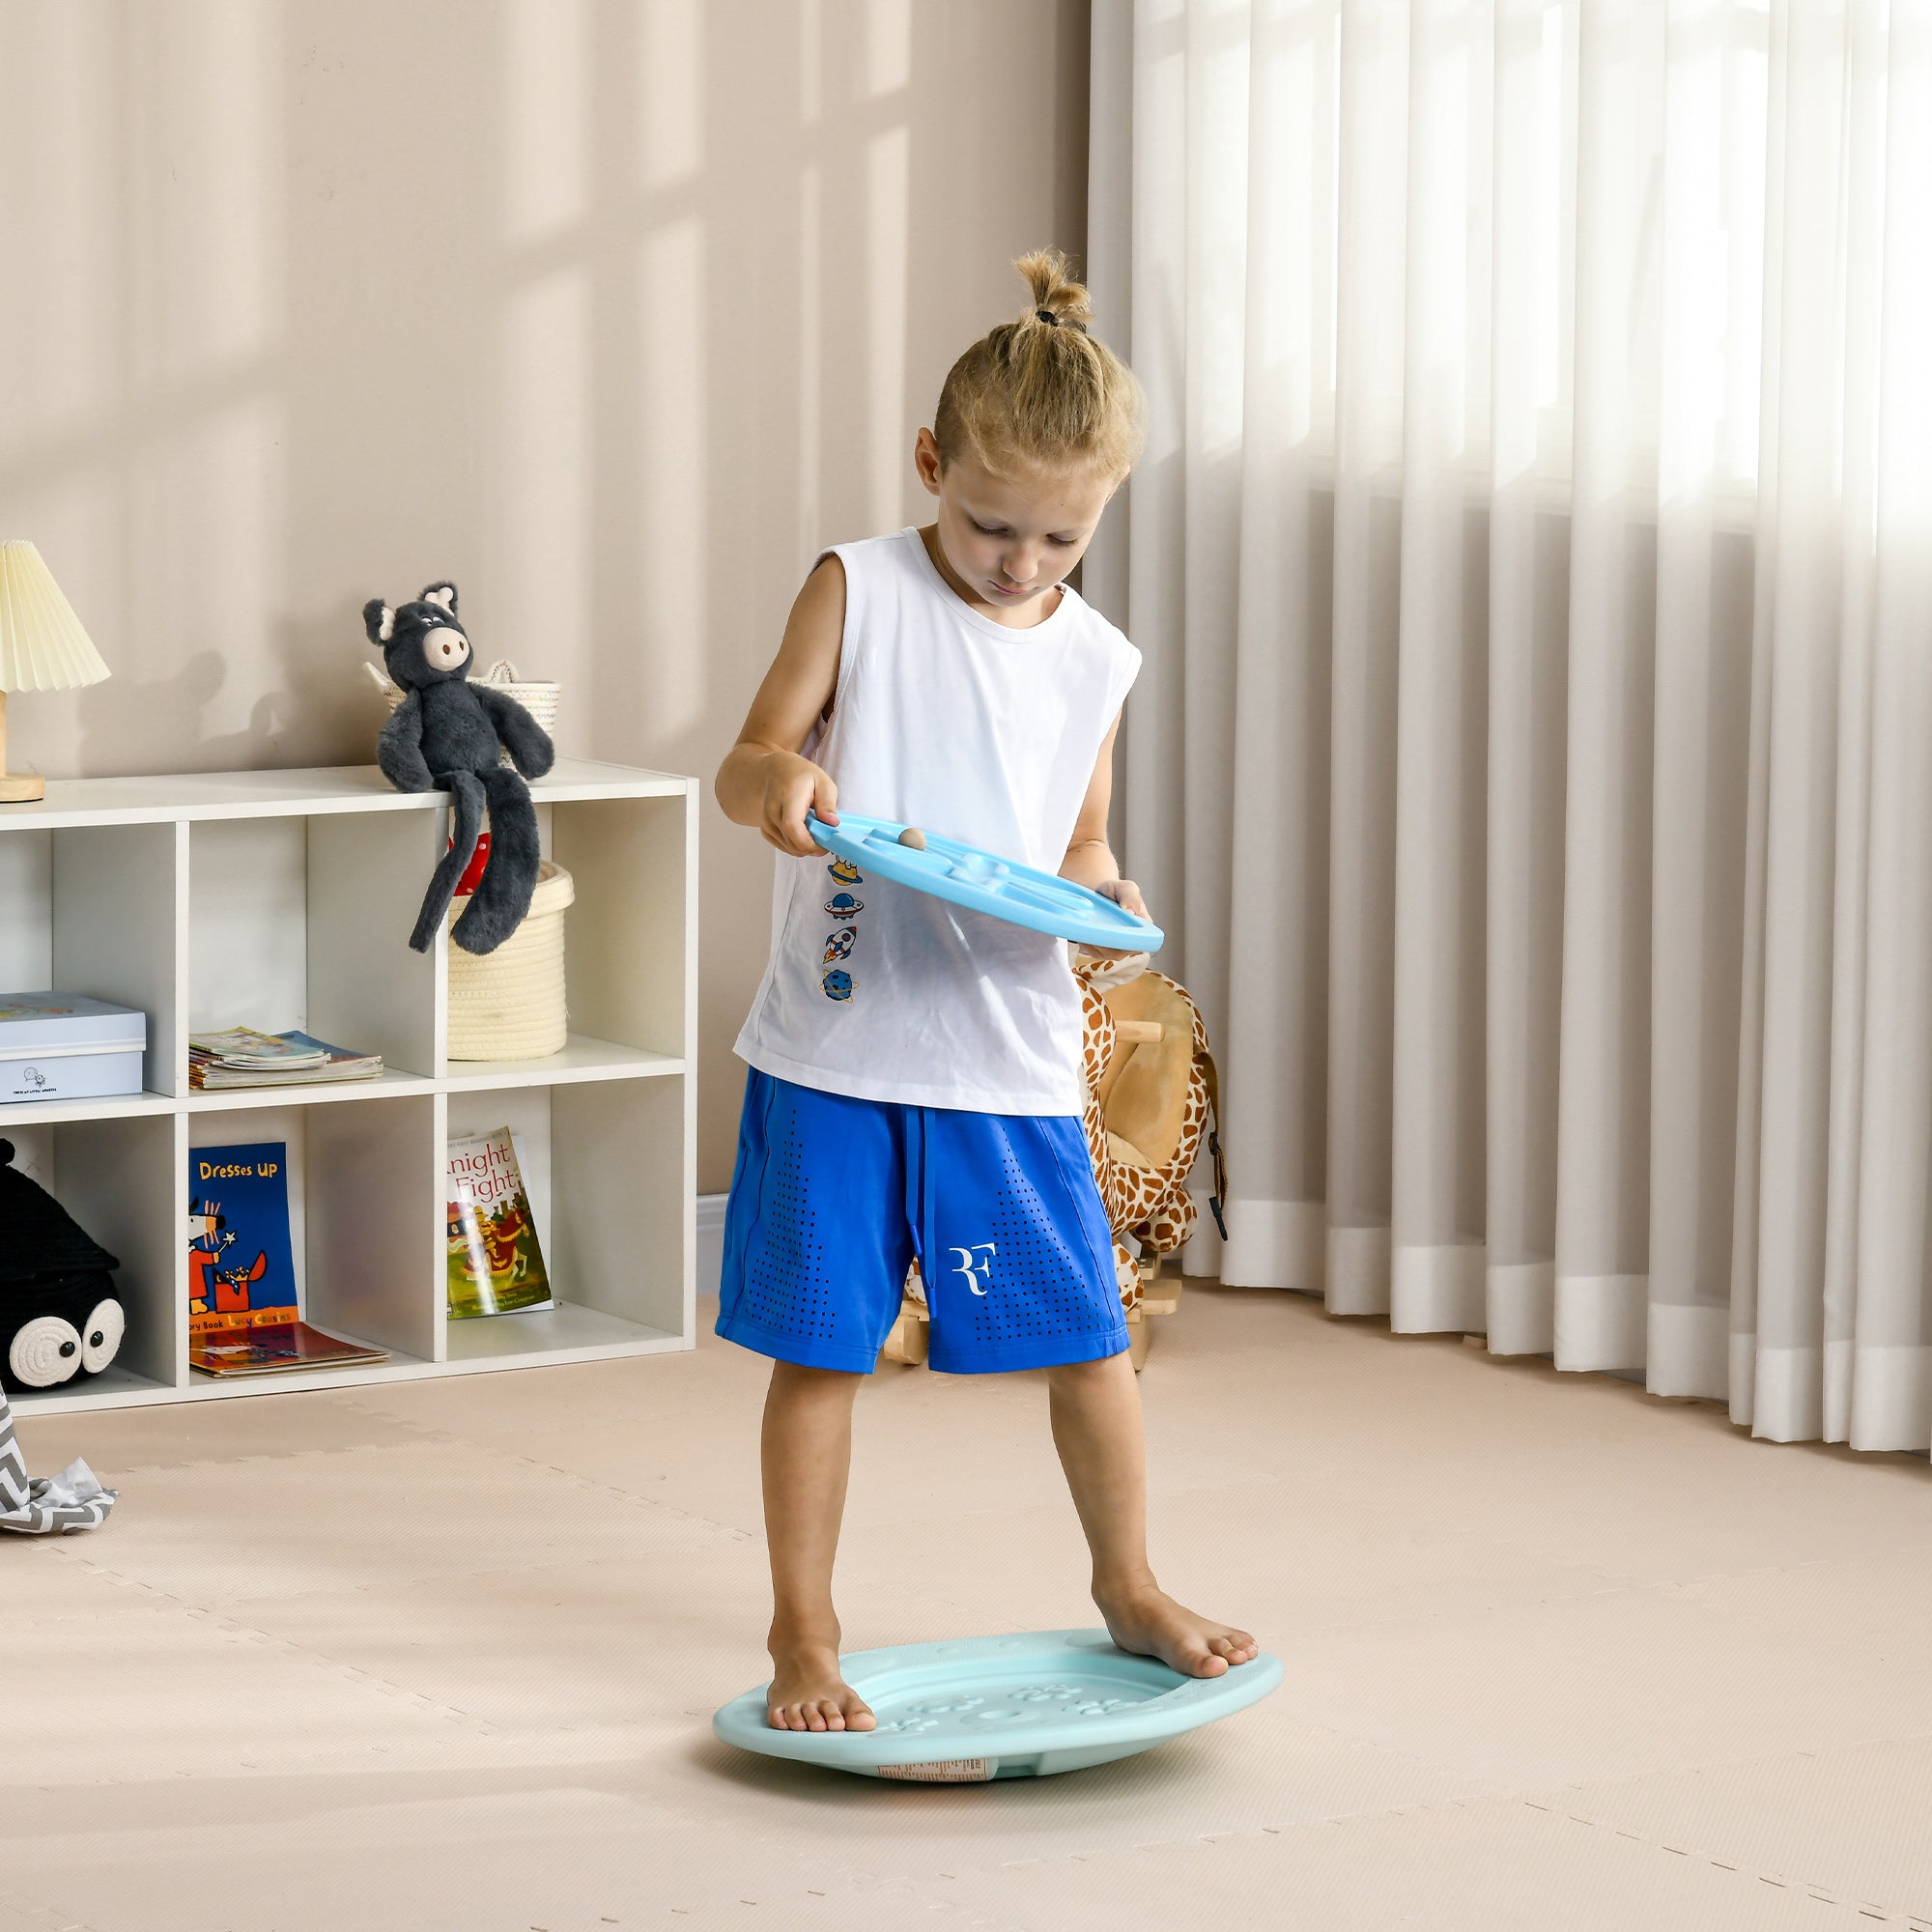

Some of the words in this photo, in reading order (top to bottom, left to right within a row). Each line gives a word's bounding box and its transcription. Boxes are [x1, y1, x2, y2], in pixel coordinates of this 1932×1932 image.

[199, 1162, 253, 1180] Dresses
[447, 1143, 510, 1178] night
[455, 1169, 517, 1204] Fight
[949, 1242, 996, 1296] RF
[203, 1320, 224, 1330] Book
[227, 1314, 253, 1329] Lucy
[254, 1312, 292, 1324] Cousins
